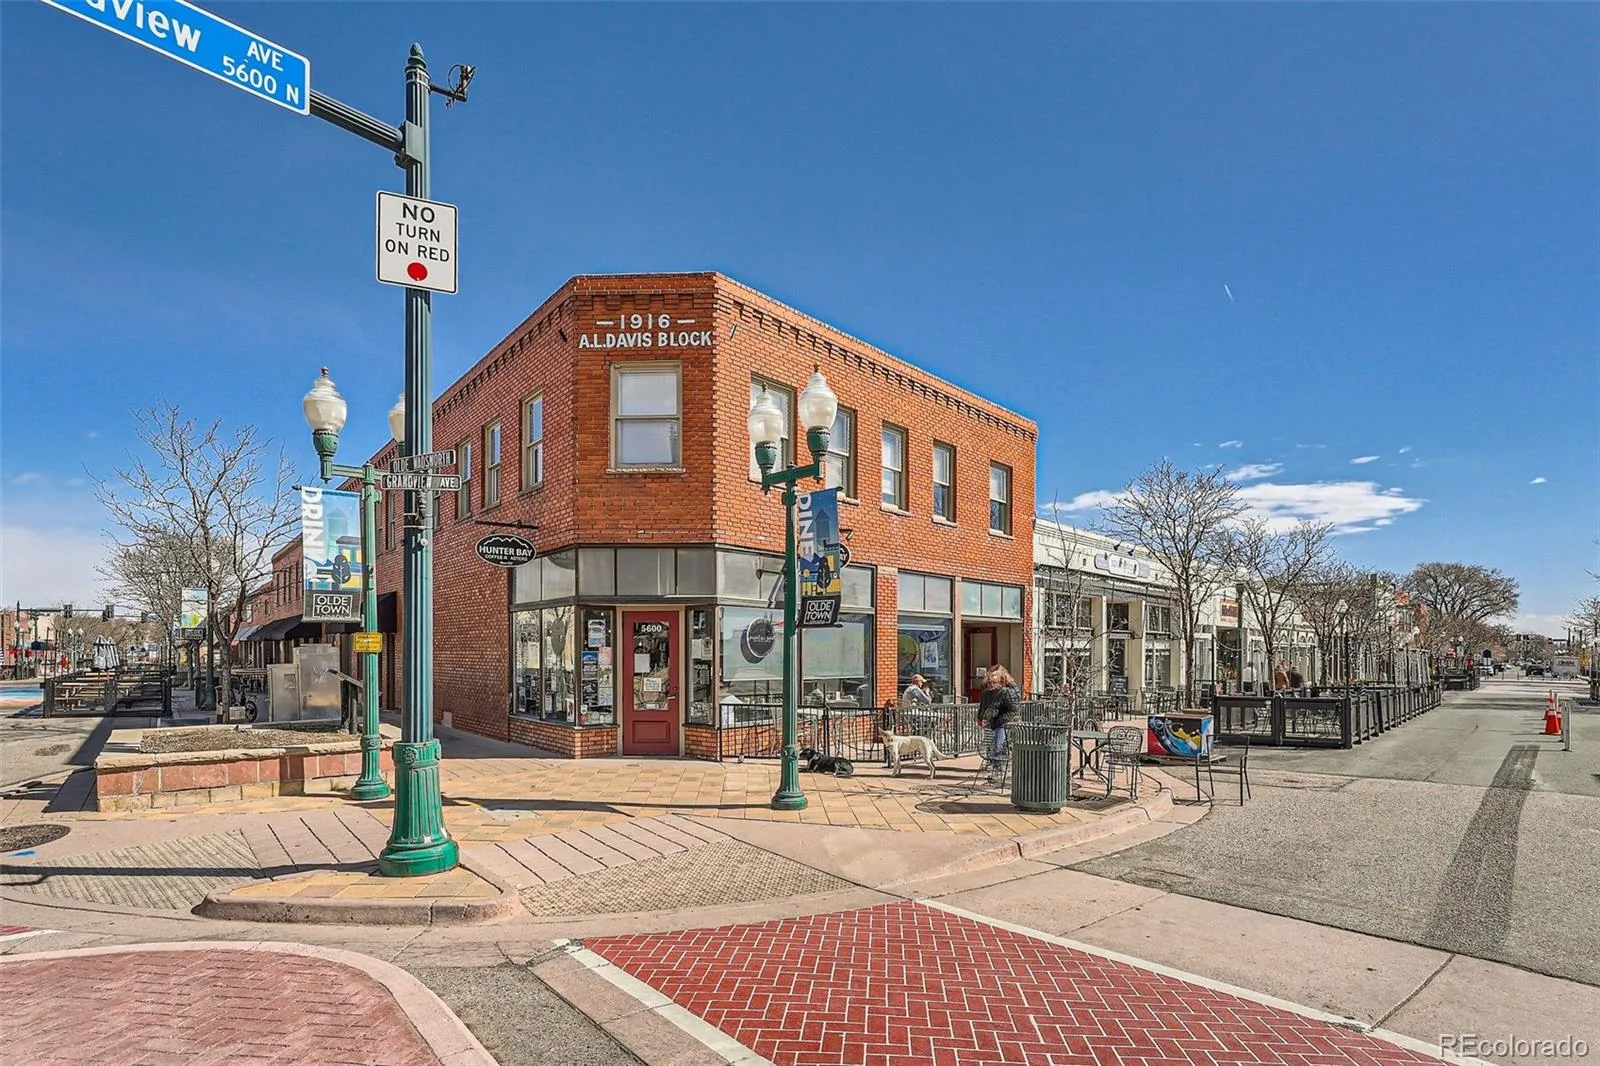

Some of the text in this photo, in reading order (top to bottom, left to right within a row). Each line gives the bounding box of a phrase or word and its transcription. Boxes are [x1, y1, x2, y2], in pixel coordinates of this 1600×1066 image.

[247, 41, 284, 72] AVE
[222, 56, 299, 105] 5600 N
[402, 202, 435, 223] NO
[395, 222, 440, 243] TURN
[385, 239, 450, 262] ON RED
[658, 331, 712, 347] BLOCK
[392, 452, 451, 473] OLDE WADSWORTH
[386, 475, 432, 488] GRANDVIEW
[799, 494, 814, 557] DINE
[479, 545, 533, 557] HUNTER BAY
[315, 605, 350, 614] TOWN
[317, 596, 348, 606] OLDE
[809, 601, 831, 611] OLDE
[807, 611, 831, 620] TOWN
